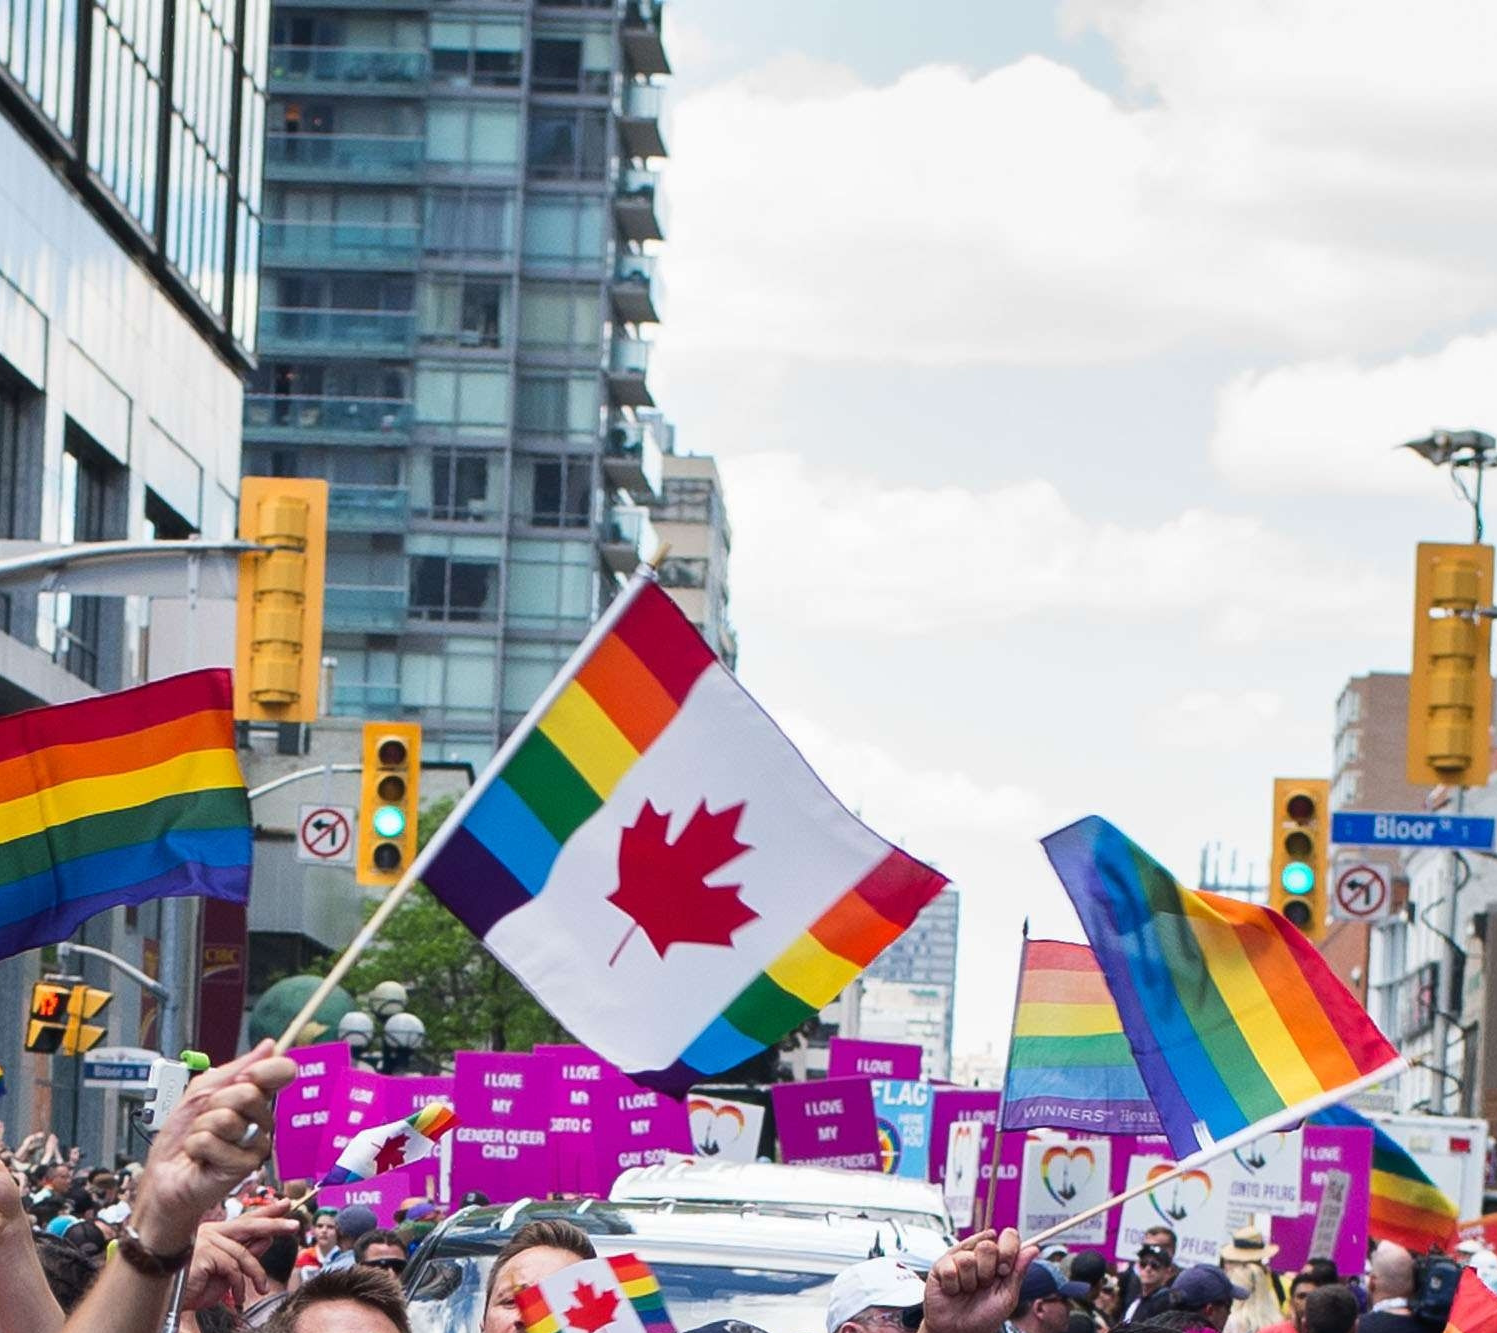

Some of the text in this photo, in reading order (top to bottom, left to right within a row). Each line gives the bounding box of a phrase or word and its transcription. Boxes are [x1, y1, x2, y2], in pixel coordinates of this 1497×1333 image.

[1373, 815, 1437, 841] Bloor
[569, 1065, 601, 1081] LOVE
[863, 1058, 894, 1075] LOVE
[492, 1073, 523, 1089] LOVE
[491, 1099, 513, 1114] MY
[625, 1092, 658, 1109] LOVE
[811, 1098, 845, 1116] LOVE
[1023, 1104, 1107, 1123] WINNERS
[630, 1119, 652, 1135] MY
[817, 1125, 839, 1142] MY
[456, 1127, 547, 1146] GENDER QUEER
[481, 1144, 519, 1160] CHILD
[617, 1150, 644, 1168] GAY
[353, 1190, 382, 1206] LOVE
